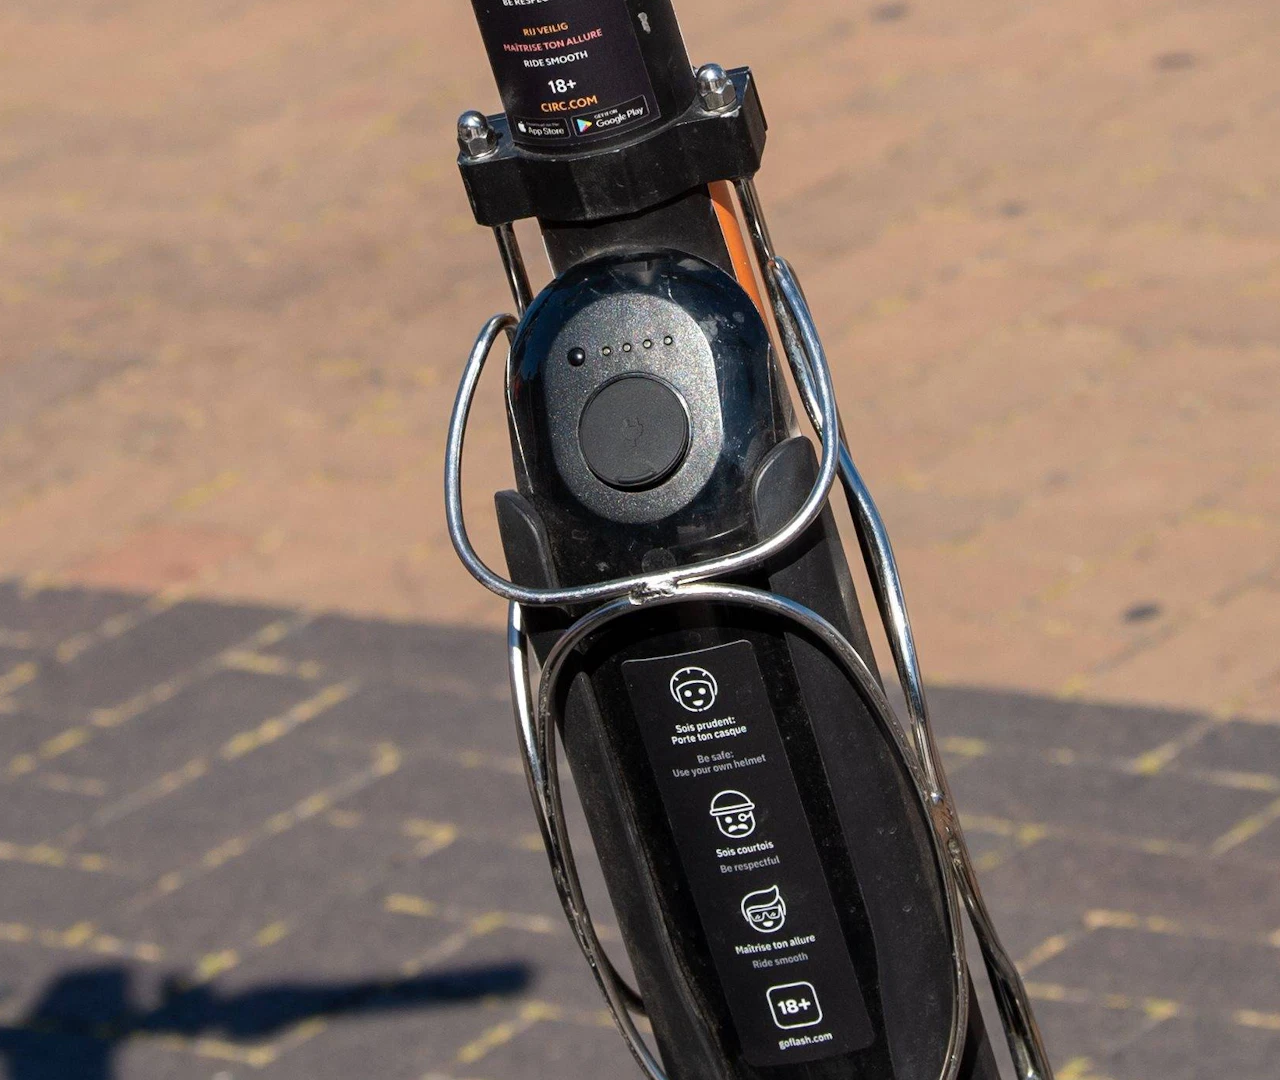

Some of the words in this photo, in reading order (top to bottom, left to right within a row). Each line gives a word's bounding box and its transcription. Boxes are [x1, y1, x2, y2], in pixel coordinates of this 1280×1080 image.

[523, 27, 536, 36] RIJ
[536, 22, 568, 35] VEILIG
[503, 42, 542, 52] MAÎTRISE
[544, 40, 565, 50] TON
[566, 28, 603, 46] ALLURE
[524, 58, 544, 68] RIDE
[546, 50, 588, 66] SMOOTH
[548, 78, 577, 94] 18+
[541, 95, 598, 113] CIRC.COM
[596, 113, 626, 128] Google
[626, 107, 644, 118] Play
[528, 127, 542, 136] App
[675, 723, 695, 733] Sois
[696, 716, 736, 731] prudent:
[671, 735, 696, 745] Porte
[698, 731, 713, 741] ton
[714, 725, 747, 739] casque
[672, 768, 690, 778] Use
[691, 764, 711, 777] your
[712, 764, 733, 772] own
[733, 754, 766, 769] helmet
[697, 754, 710, 764] Be
[711, 750, 734, 762] safe:
[716, 848, 736, 858] Sois
[737, 841, 774, 854] courtois
[720, 864, 732, 873] Be
[734, 855, 780, 871] respectful
[735, 943, 772, 955] Maîtrise
[773, 940, 789, 950] ton
[789, 934, 816, 947] allure
[752, 959, 774, 969] Ride
[775, 952, 808, 966] smooth
[777, 998, 811, 1015] 18+
[778, 1032, 833, 1051] goflash.com
